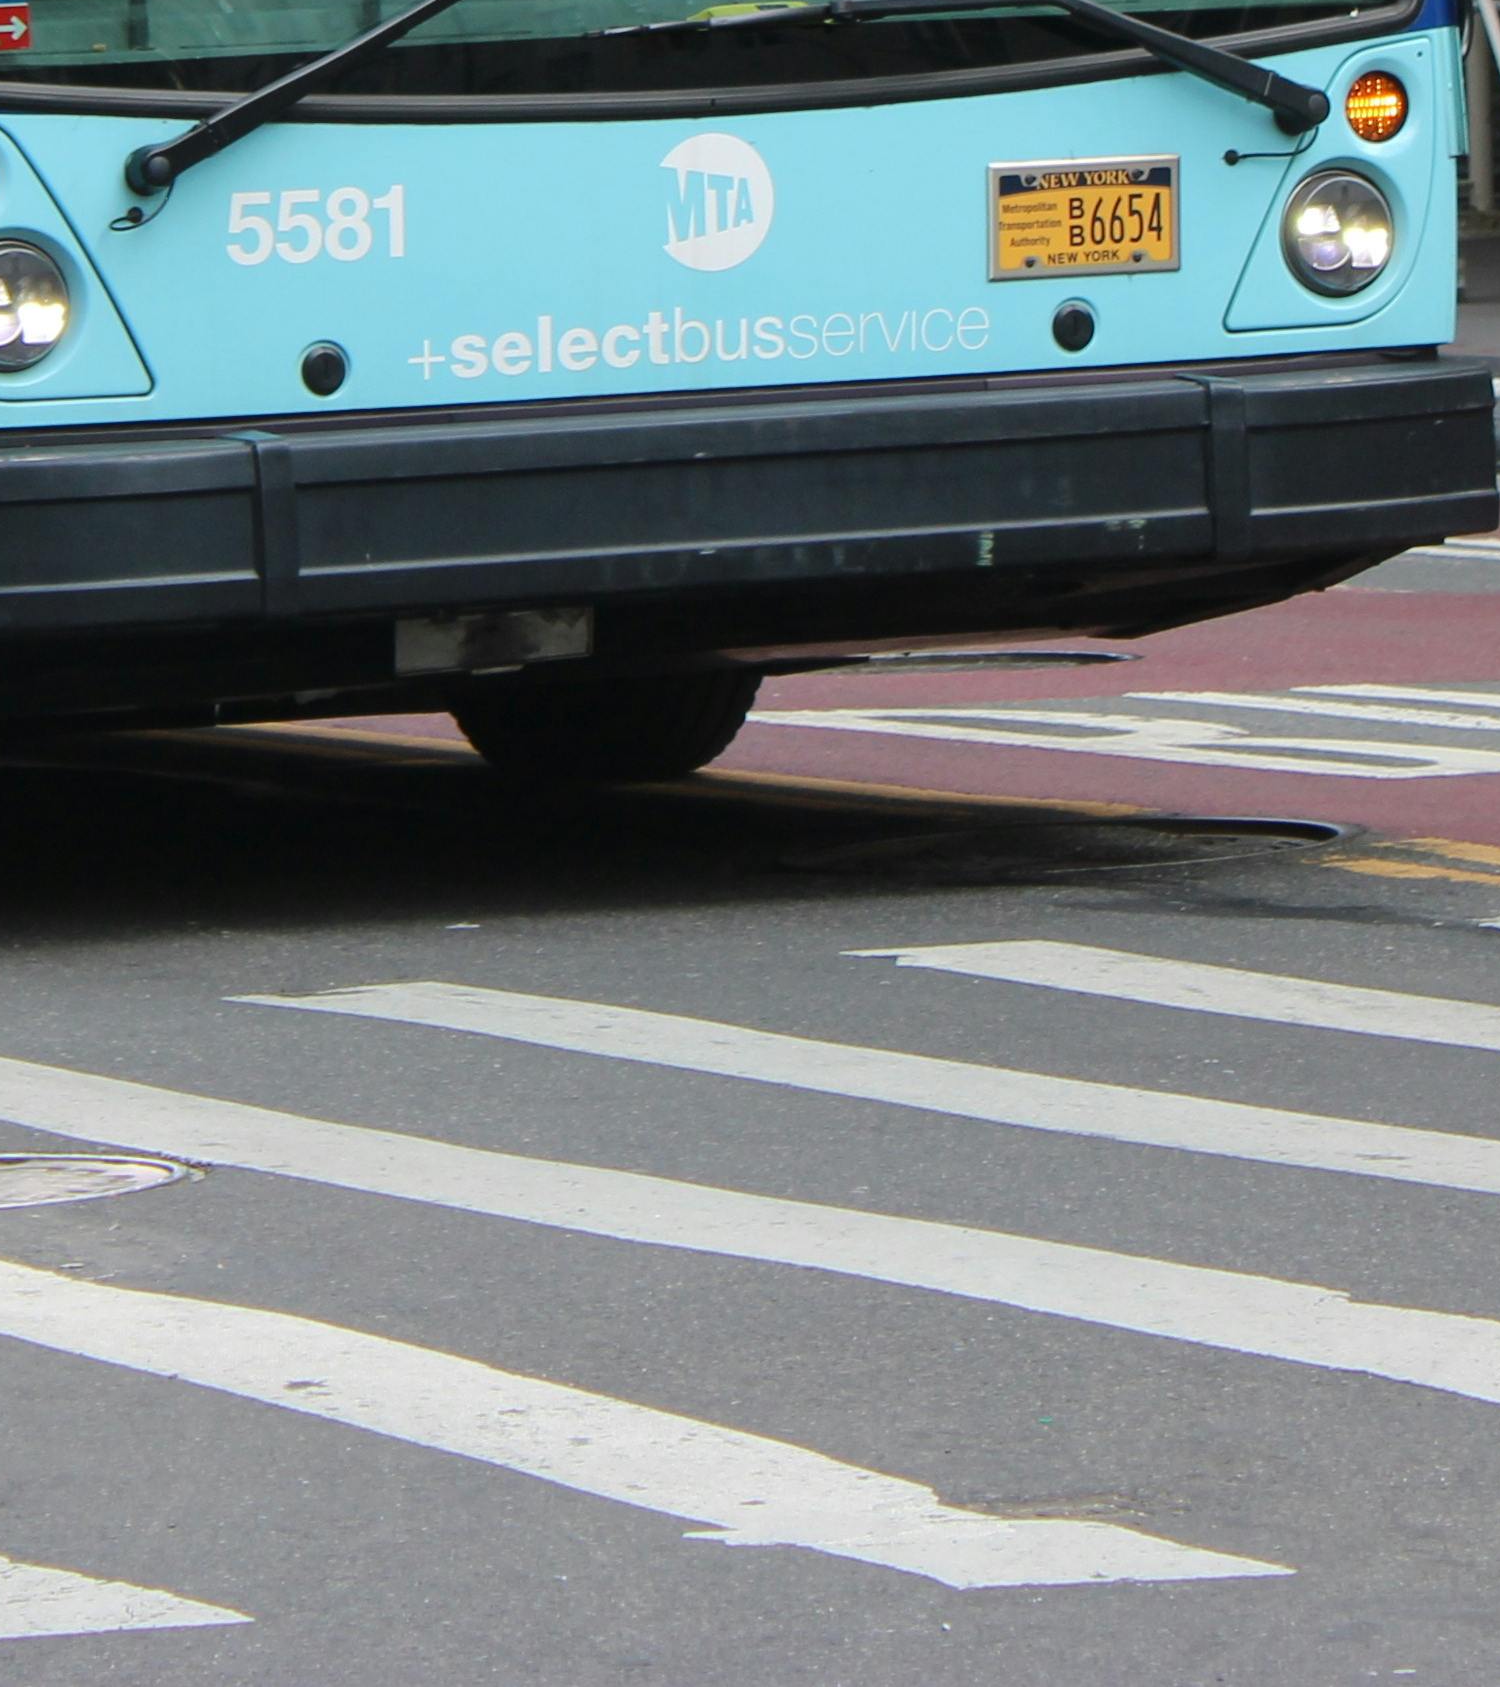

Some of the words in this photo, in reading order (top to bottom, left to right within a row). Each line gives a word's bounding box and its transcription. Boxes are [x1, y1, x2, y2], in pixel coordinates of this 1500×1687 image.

[1037, 170, 1079, 190] NEW
[1084, 168, 1130, 186] YORK
[226, 185, 406, 265] 5581
[1010, 236, 1051, 248] Authority
[1048, 252, 1078, 265] NEW
[1083, 249, 1120, 262] YORK
